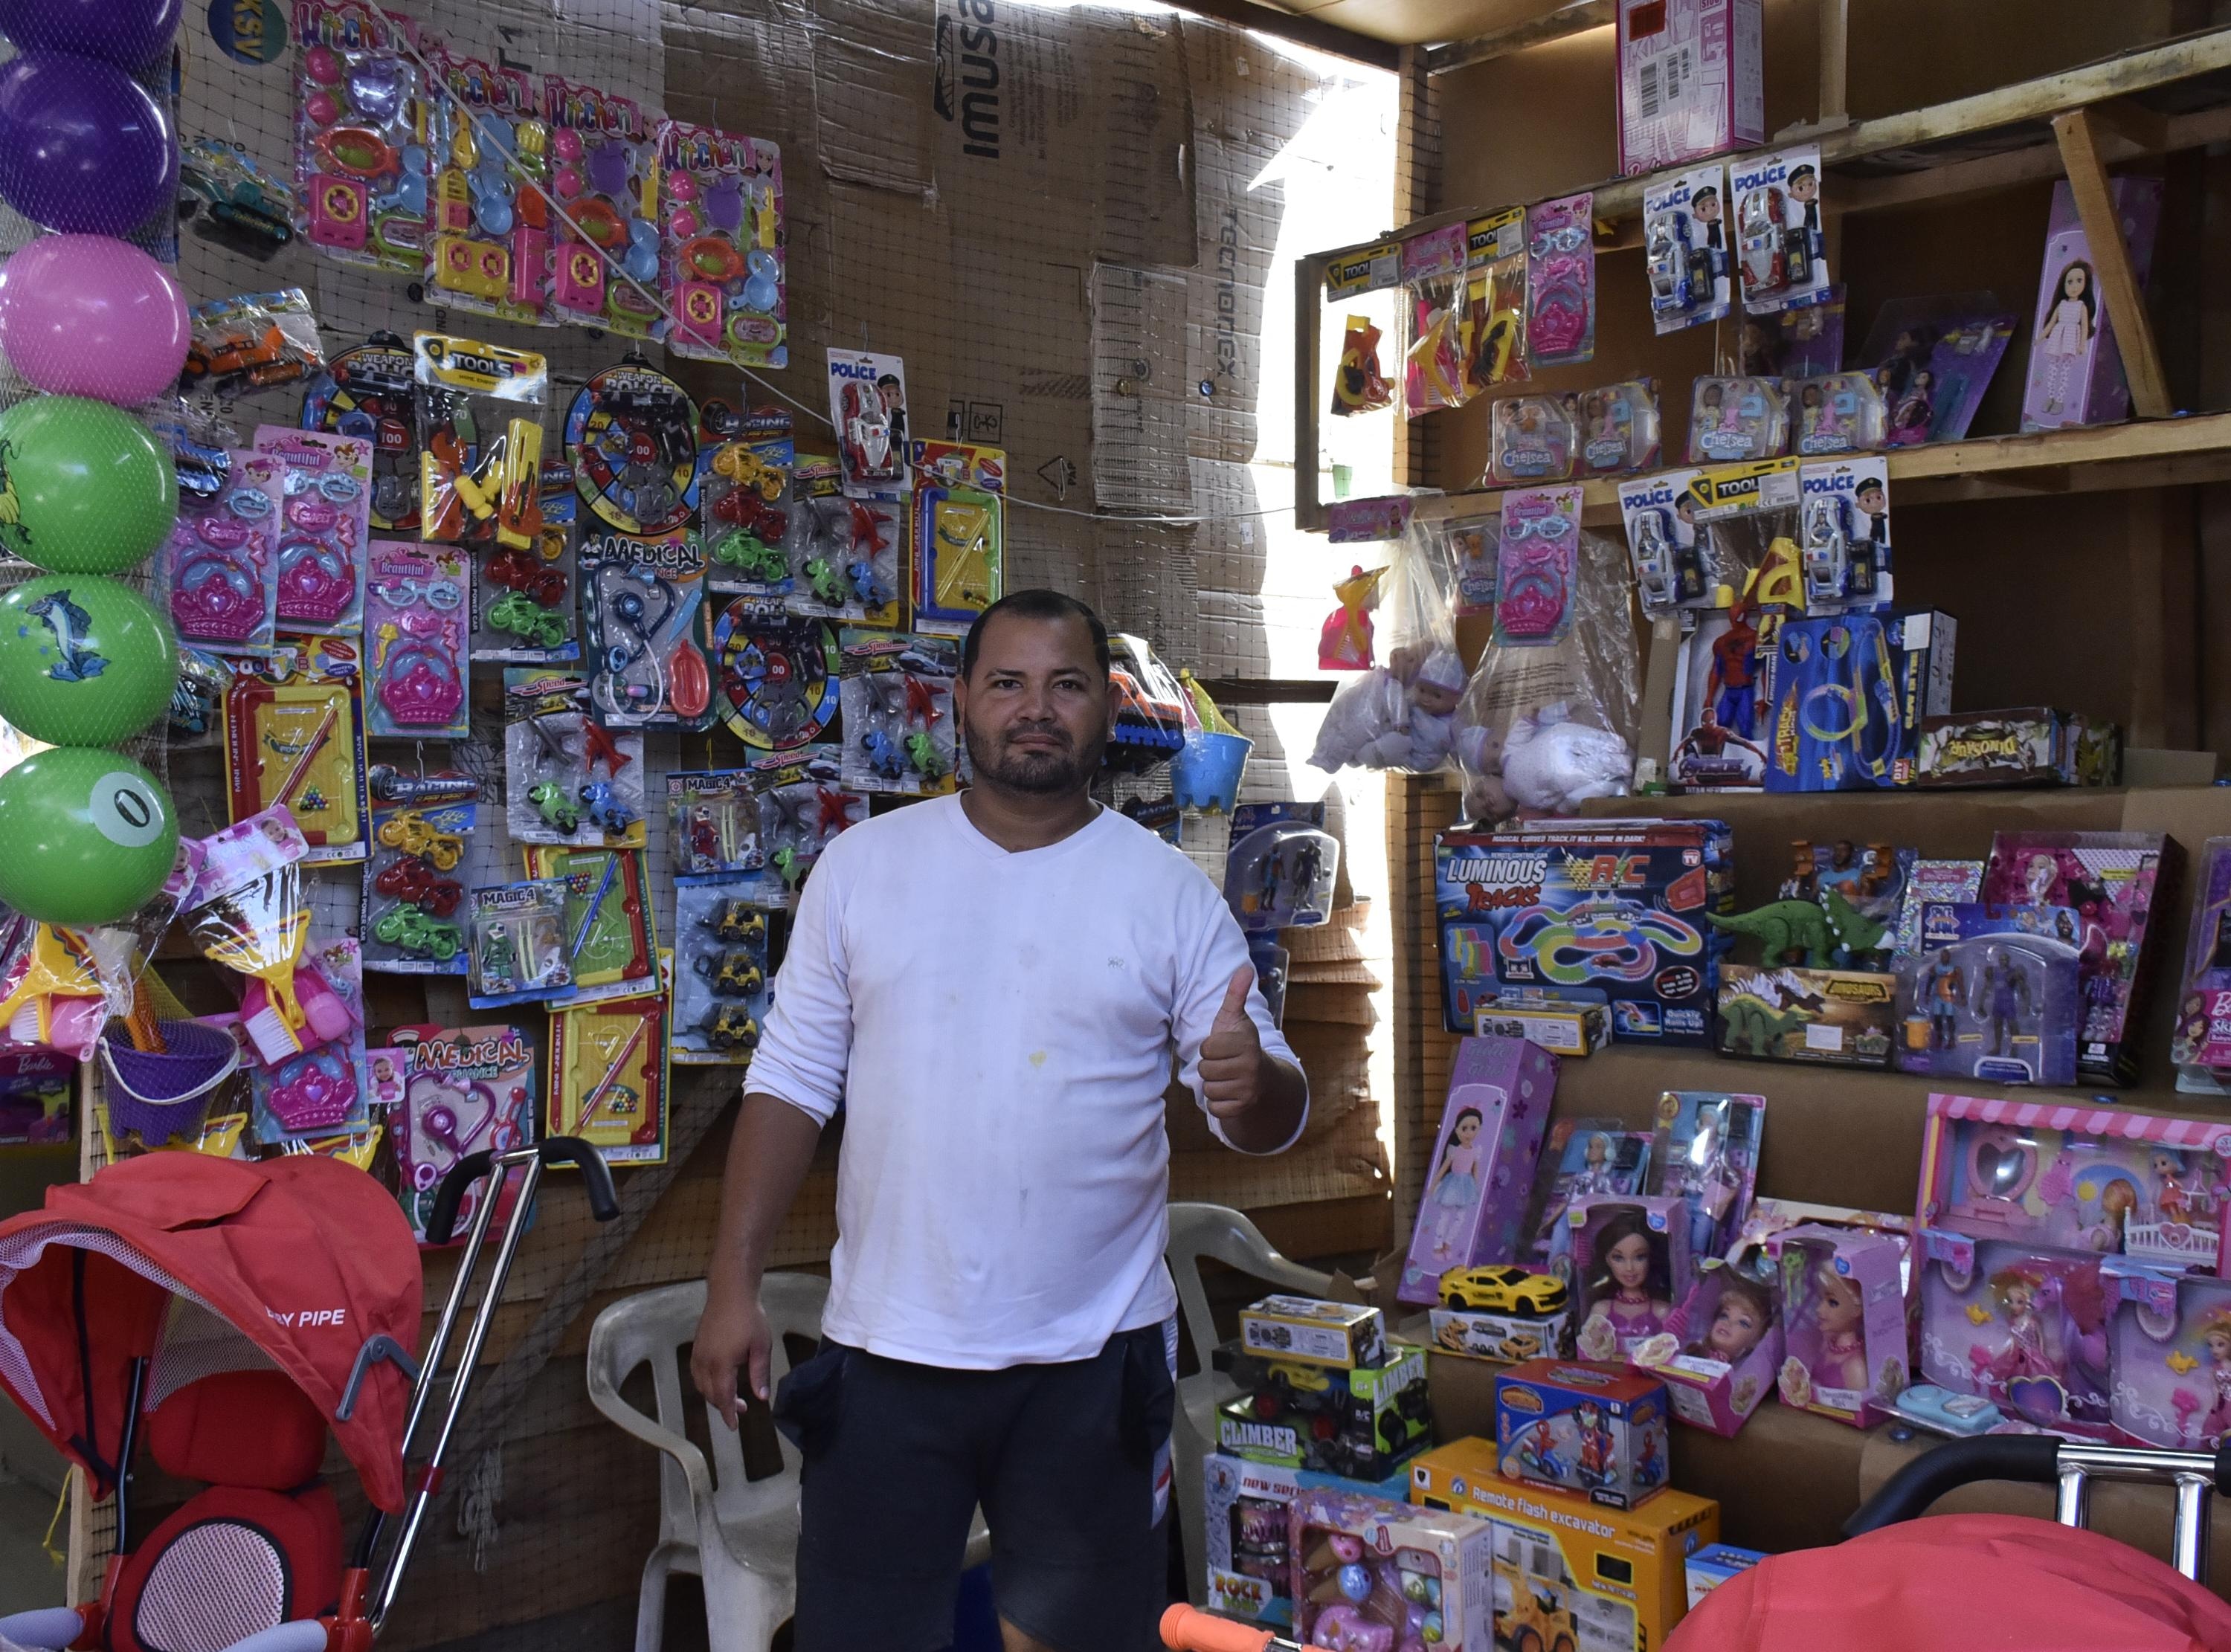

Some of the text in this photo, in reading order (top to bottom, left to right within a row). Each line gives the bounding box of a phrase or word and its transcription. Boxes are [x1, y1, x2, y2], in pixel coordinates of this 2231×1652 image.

[298, 2, 406, 52] Kitchen
[549, 86, 632, 134] Kitchen
[663, 130, 747, 171] Kitchen
[1345, 262, 1371, 279] TOOL
[361, 353, 413, 365] WEAPON
[453, 353, 512, 377] TOOLS
[618, 372, 661, 384] WEAPON
[831, 362, 877, 381] POLICE
[1586, 440, 1626, 458] Chelsea
[1701, 433, 1753, 449] Chelsea
[1801, 435, 1847, 451] Chelsea
[1503, 451, 1551, 467] Chelsea
[1718, 480, 1759, 496] TOOL
[1803, 474, 1855, 494] POLICE
[1623, 488, 1673, 510] POLICE
[603, 537, 705, 568] MEDICAL
[381, 561, 425, 576] Beautiful
[1461, 580, 1496, 595] Chelse
[744, 603, 785, 616] POLI
[756, 596, 782, 606] WEAP
[824, 645, 837, 654] 10
[867, 640, 893, 654] Speed
[536, 677, 567, 694] Speed
[825, 695, 837, 704] 10
[396, 780, 477, 793] RACING
[1136, 804, 1175, 817] RACIN
[1683, 856, 1699, 865] TV
[1446, 859, 1548, 883] LUMINOUS
[1466, 883, 1542, 913] TRACKS
[413, 1038, 530, 1071] MEDICAL
[18, 1054, 54, 1074] Barbie
[299, 1309, 346, 1328] PIPE
[1374, 1353, 1426, 1413] LIMBER
[1220, 1421, 1297, 1454] CLIMBER
[1274, 1483, 1304, 1497] seri
[1472, 1487, 1515, 1511] Remote
[1517, 1500, 1548, 1520] flash
[1551, 1510, 1616, 1539] excavator
